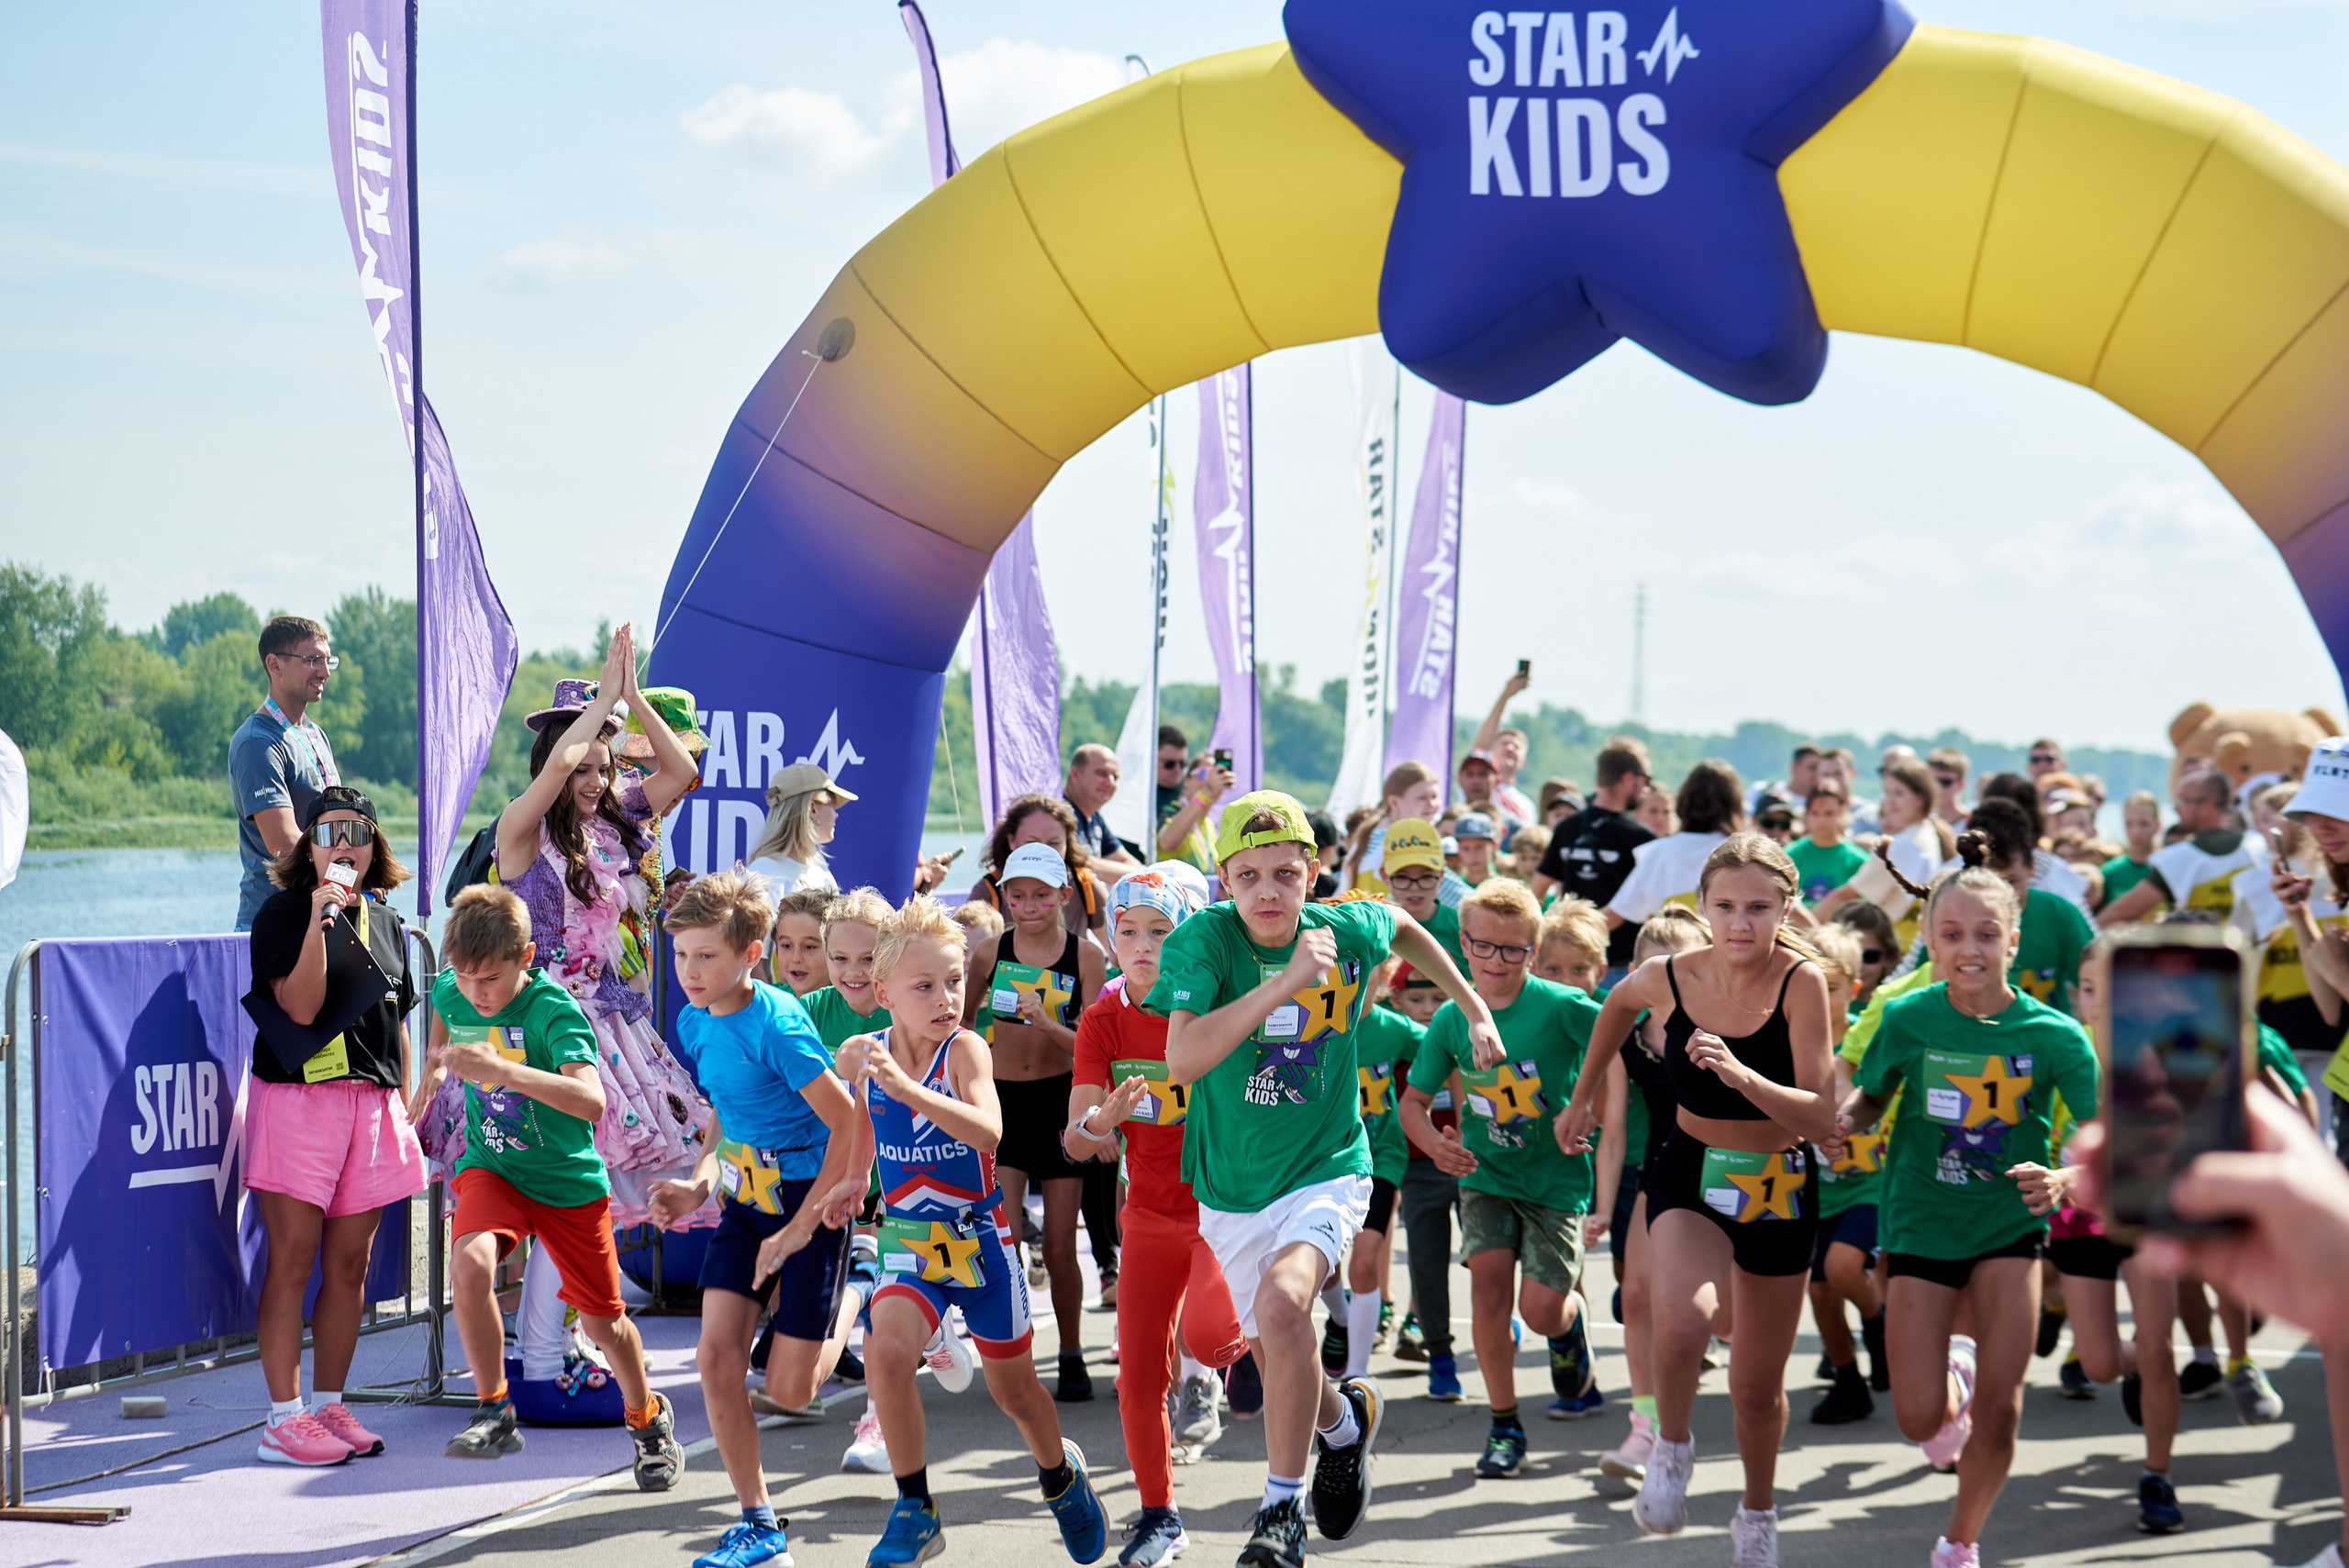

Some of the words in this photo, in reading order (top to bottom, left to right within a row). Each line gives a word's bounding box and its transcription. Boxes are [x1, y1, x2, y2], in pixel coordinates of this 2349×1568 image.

[1468, 10, 1628, 87] STAR
[1468, 92, 1671, 198] KIDS
[329, 871, 351, 883] LADY
[1320, 990, 1335, 1019] 1
[1169, 1084, 1186, 1108] 1
[1244, 1086, 1279, 1106] KIDS
[1247, 1075, 1275, 1092] STAR
[1500, 1085, 1517, 1107] 1
[1982, 1081, 1998, 1109] 1
[130, 1061, 219, 1154] STAR
[1360, 1086, 1369, 1107] 1
[879, 1140, 968, 1163] AQUATICS
[744, 1166, 754, 1192] 1
[903, 1164, 937, 1173] MOSCOW
[1761, 1176, 1776, 1203] 1
[932, 1242, 952, 1268] 1
